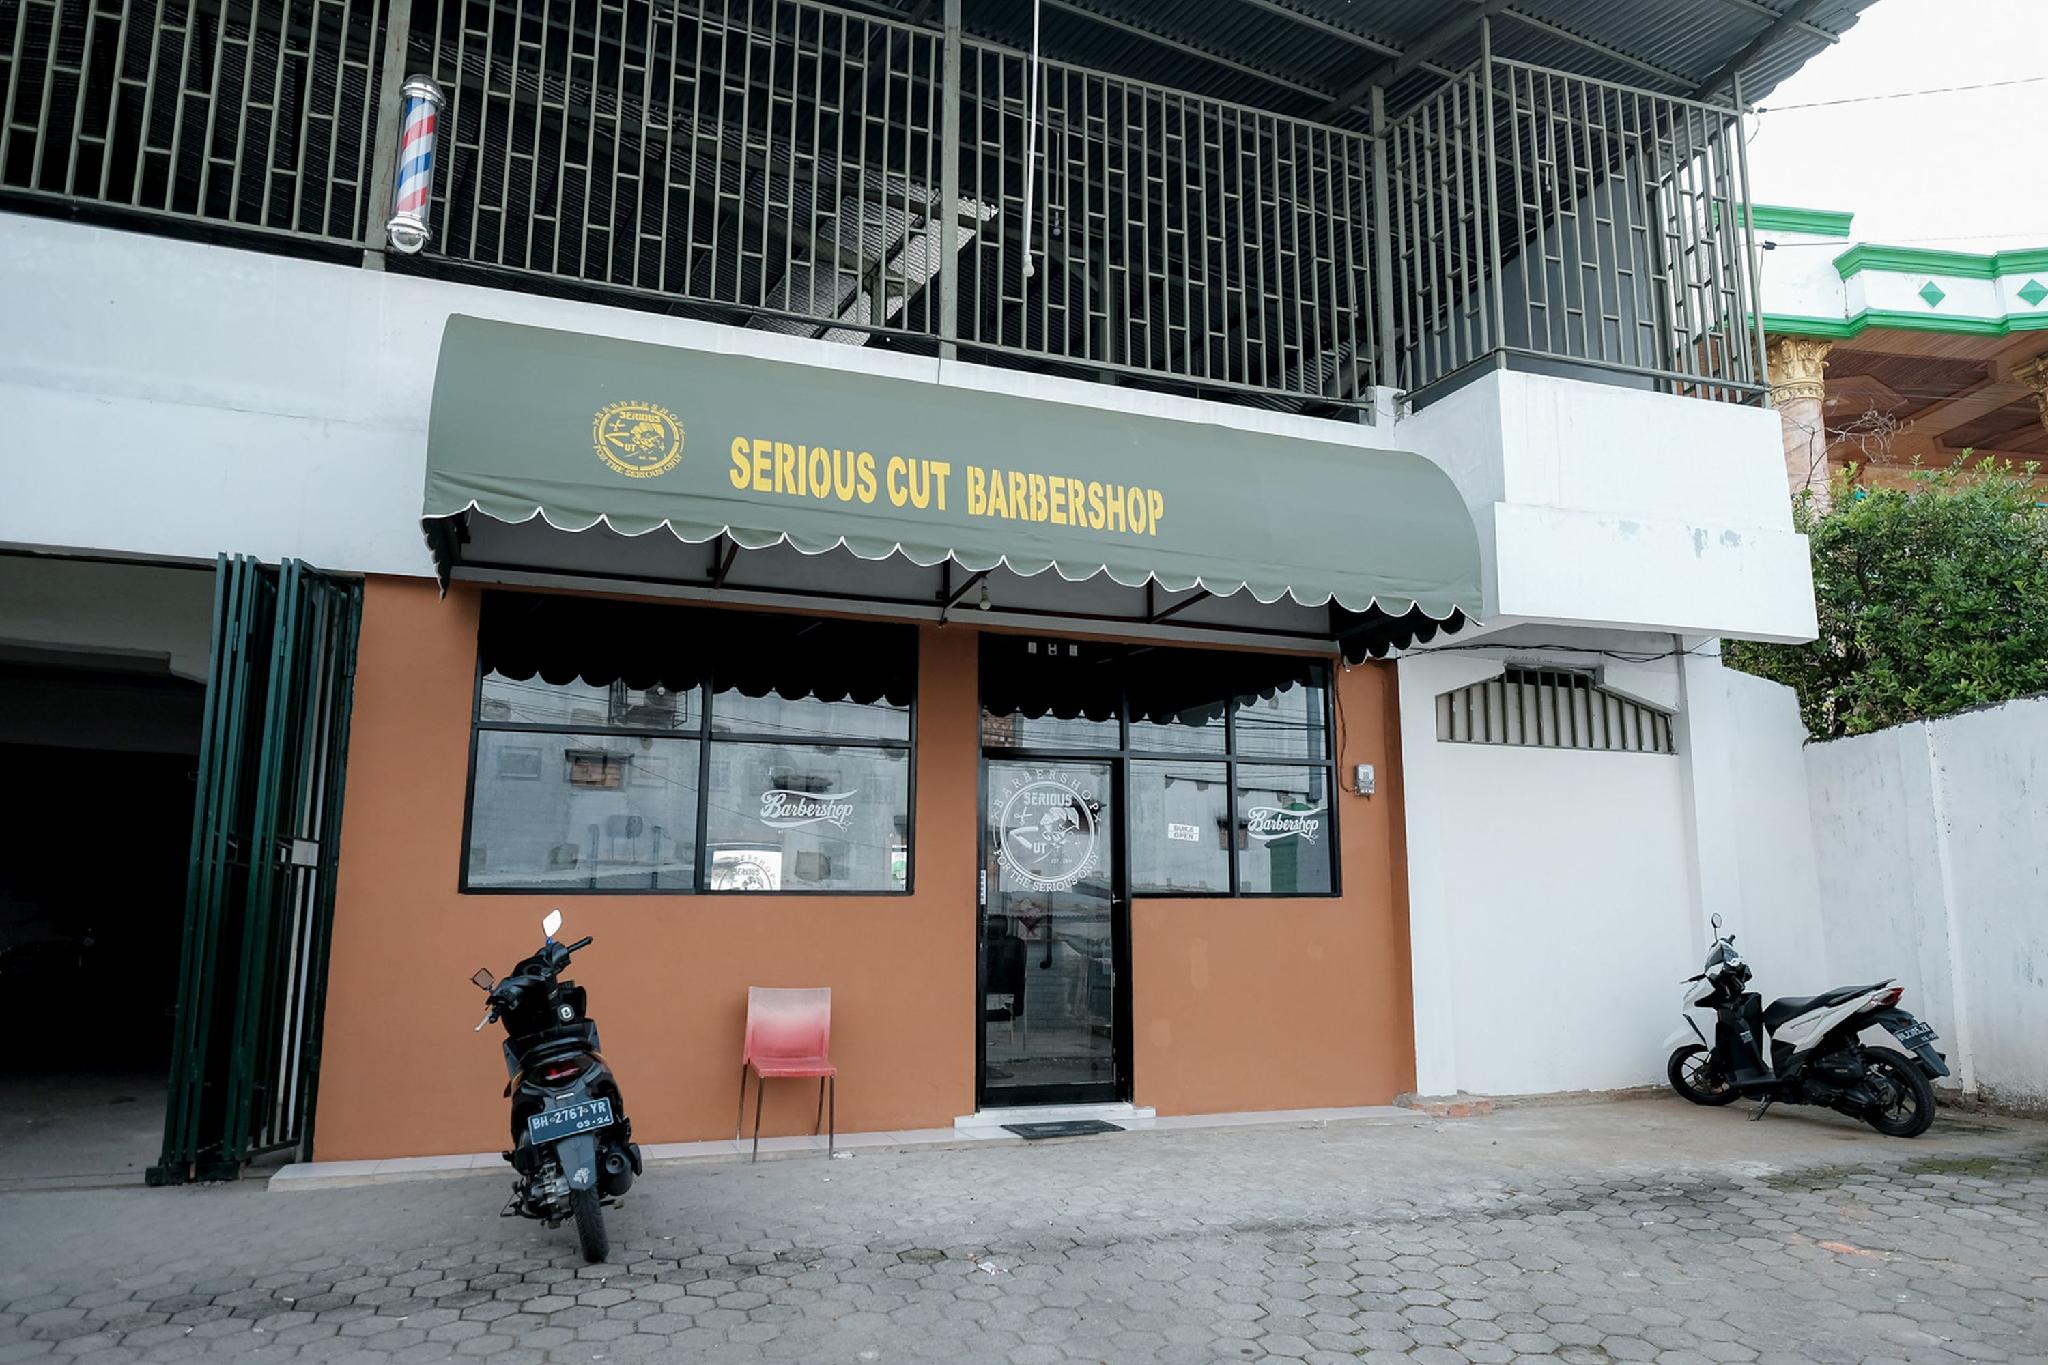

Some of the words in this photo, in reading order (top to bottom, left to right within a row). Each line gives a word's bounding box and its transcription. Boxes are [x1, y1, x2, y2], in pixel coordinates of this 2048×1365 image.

[619, 411, 661, 422] SERIOUS
[729, 435, 877, 504] SERIOUS
[886, 455, 950, 511] CUT
[966, 465, 1165, 537] BARBERSHOP
[994, 769, 1099, 810] BARBERSHOP
[1024, 792, 1072, 806] SERIOUS
[760, 792, 853, 824] Barbershop
[1173, 832, 1194, 840] OPEN
[1248, 809, 1319, 837] Barbershop
[993, 849, 1011, 871] FOR
[1010, 870, 1029, 888] THE
[1032, 877, 1078, 892] SERIOUS
[1078, 852, 1099, 879] ONLY
[532, 1116, 549, 1130] BH
[554, 1106, 583, 1124] 2767
[589, 1102, 607, 1114] YR
